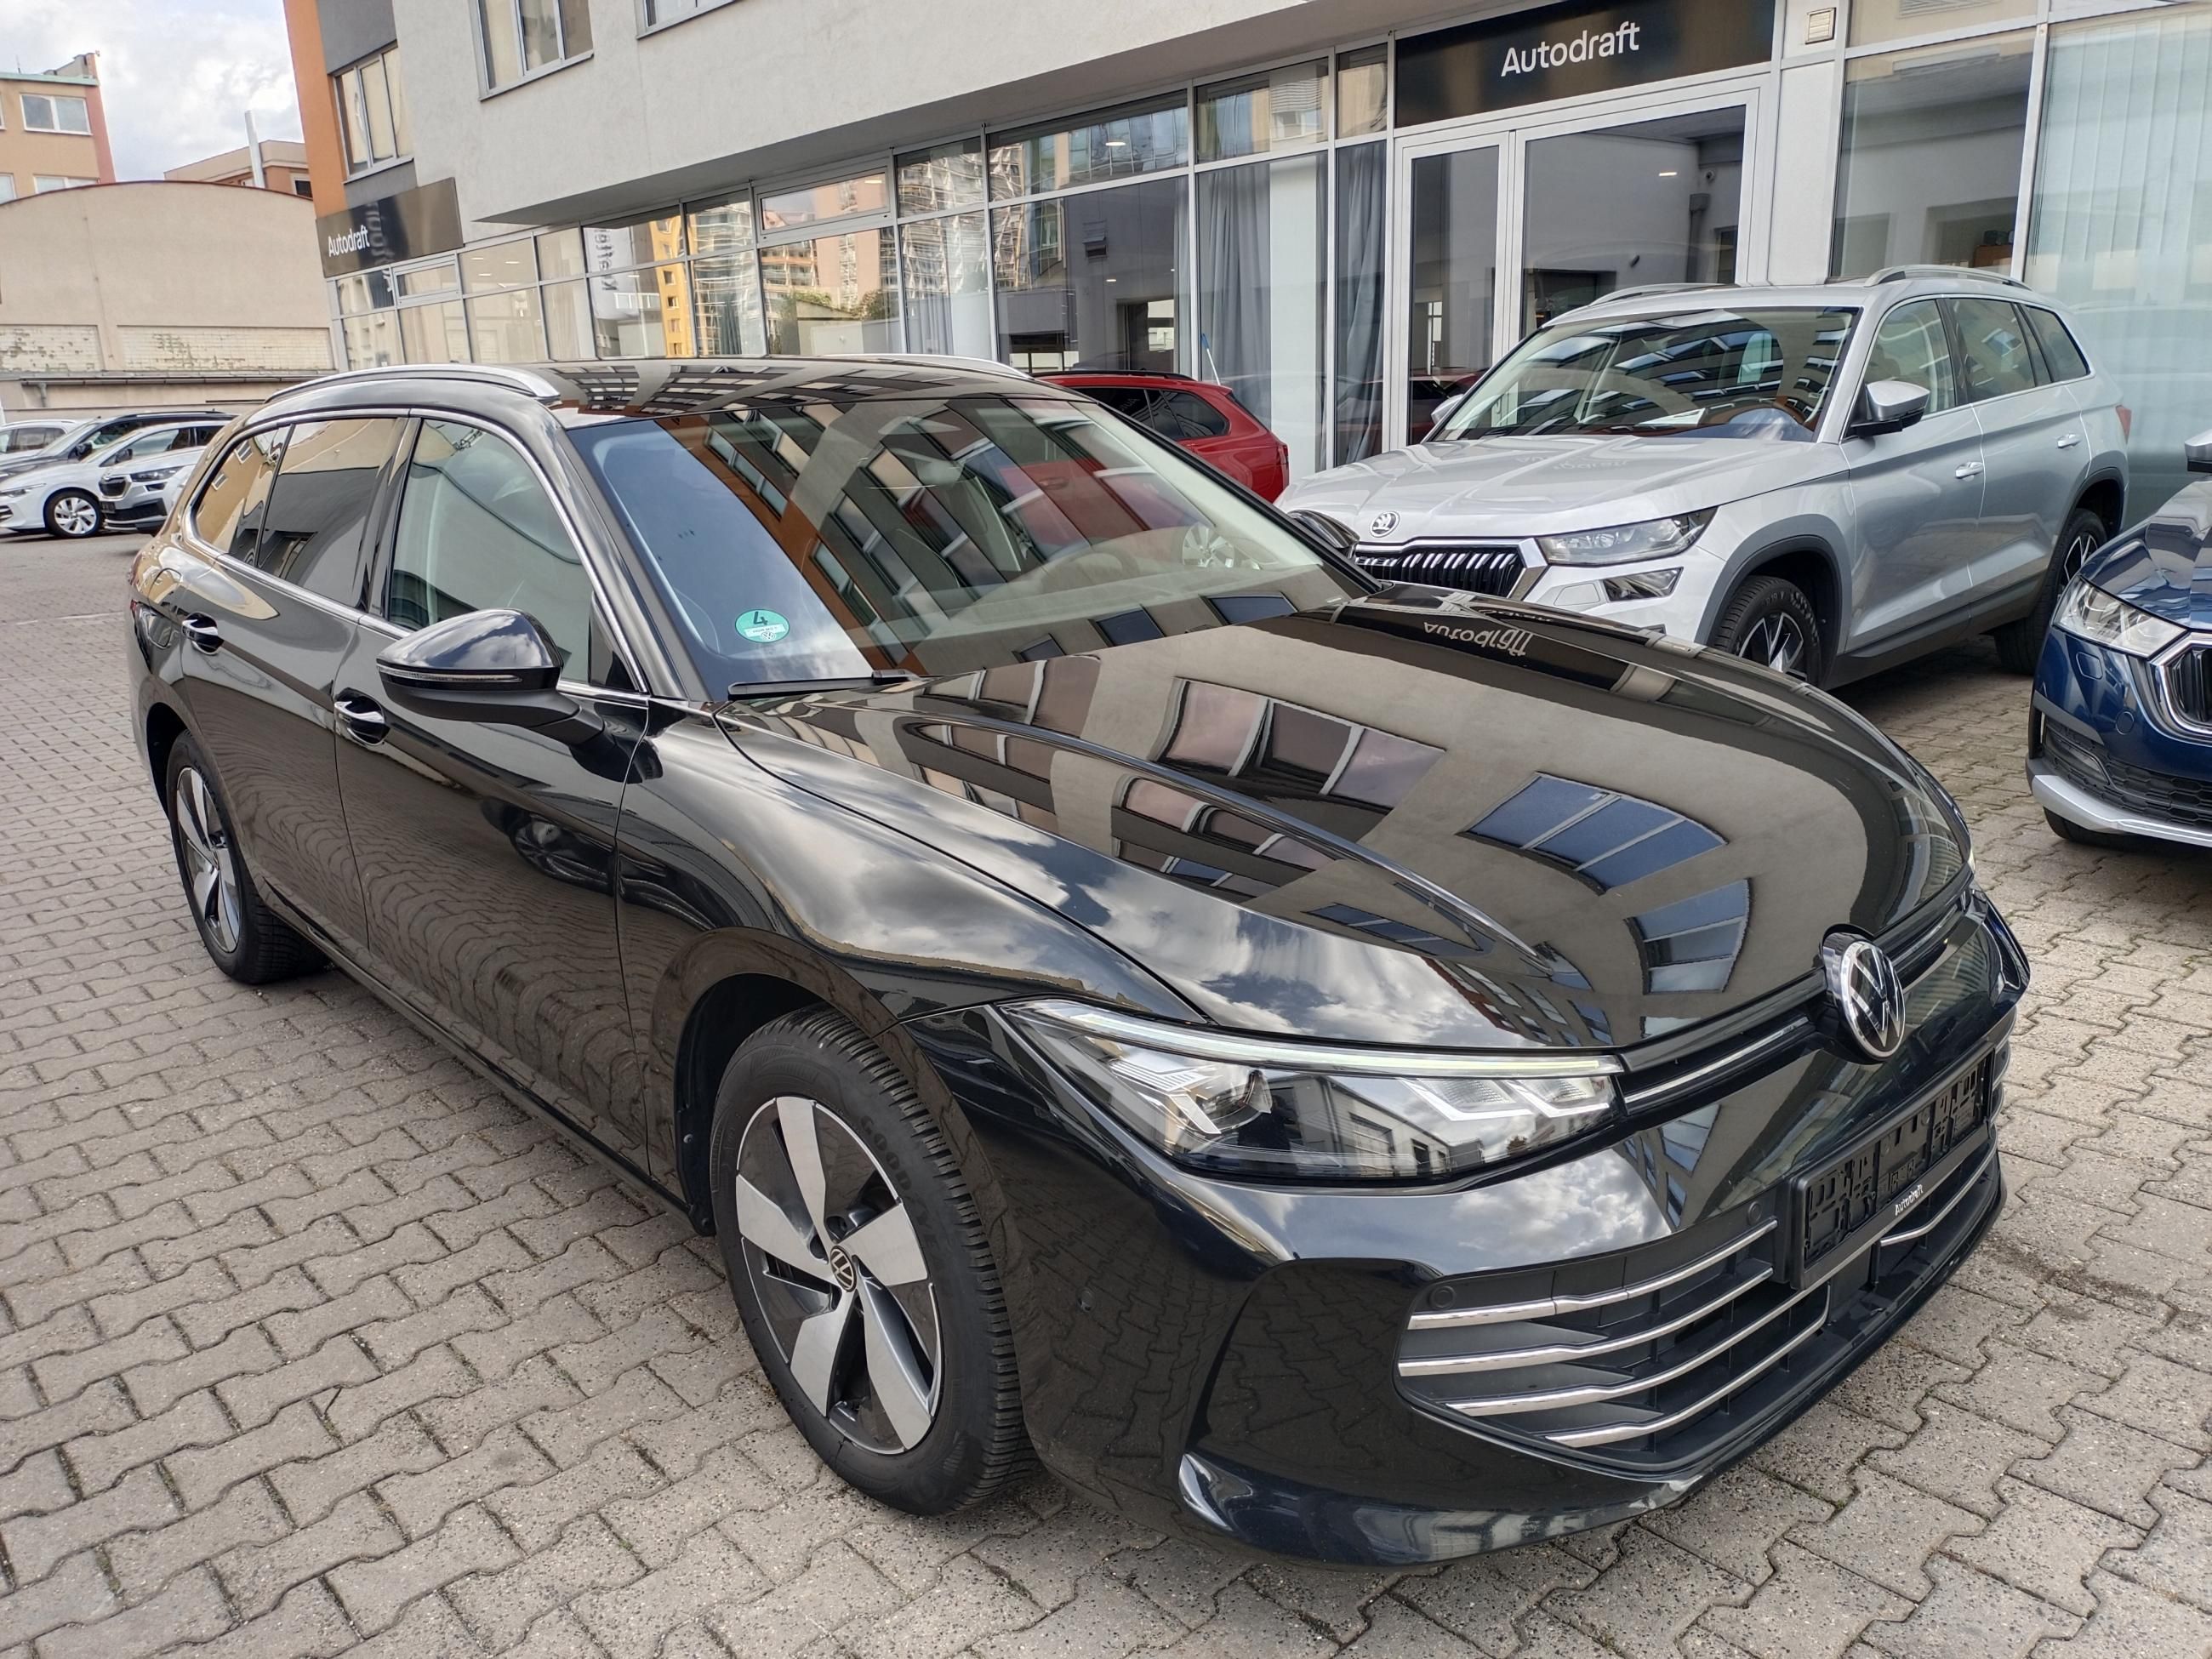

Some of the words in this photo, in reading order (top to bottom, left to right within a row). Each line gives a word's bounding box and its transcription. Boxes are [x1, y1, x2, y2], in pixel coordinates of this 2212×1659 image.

[1501, 21, 1640, 77] Autodraft
[328, 225, 370, 257] Autodraft
[754, 611, 768, 625] 4
